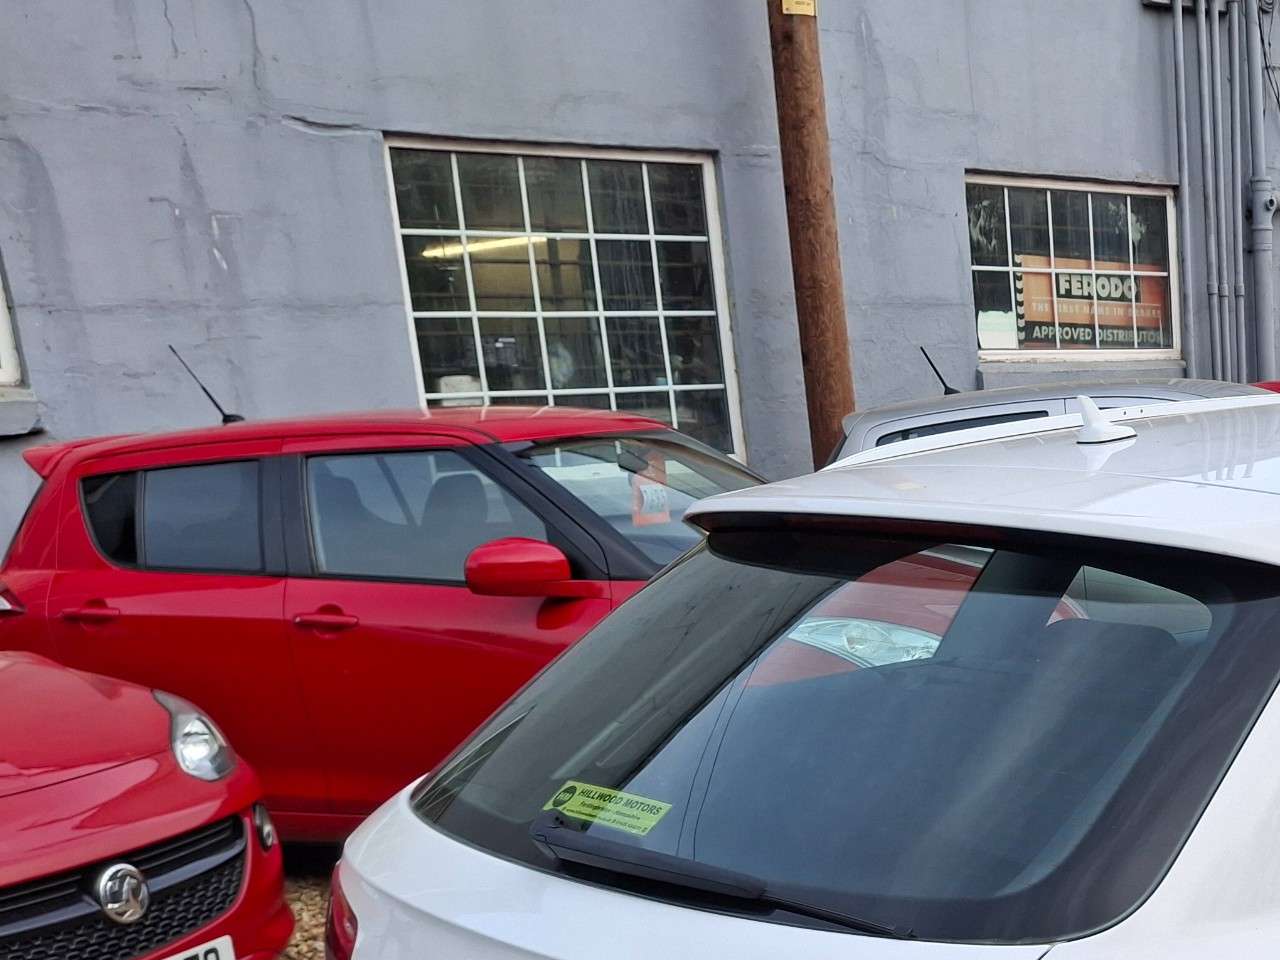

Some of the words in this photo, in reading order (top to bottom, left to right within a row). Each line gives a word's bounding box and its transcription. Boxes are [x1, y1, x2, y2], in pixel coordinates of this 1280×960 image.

[1059, 274, 1138, 299] FERODO
[1033, 325, 1093, 341] APPROVED
[578, 788, 623, 806] HILLWOOD
[622, 799, 663, 816] MOTORS
